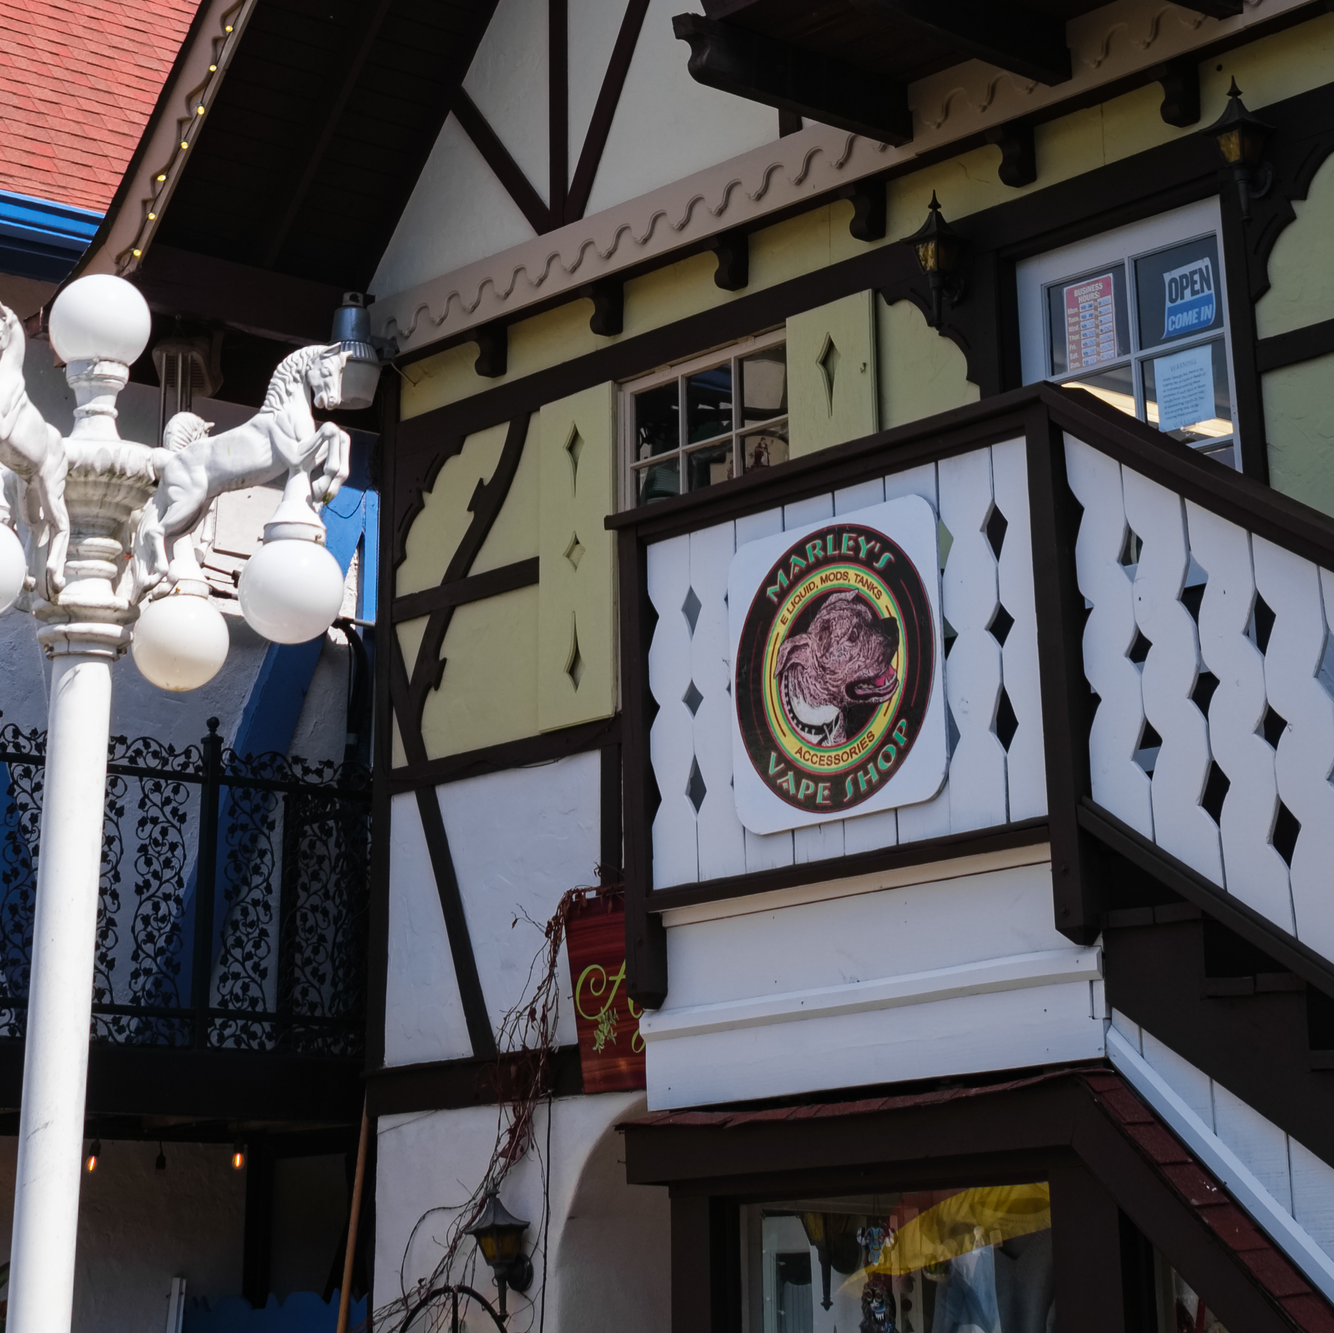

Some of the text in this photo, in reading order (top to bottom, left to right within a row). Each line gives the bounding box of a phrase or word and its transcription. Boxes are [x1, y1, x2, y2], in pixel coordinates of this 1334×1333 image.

[1074, 282, 1103, 297] BUSINESS
[1168, 264, 1212, 305] OPEN
[1168, 304, 1213, 331] COME IN
[766, 532, 896, 605] MARLEY'S
[779, 570, 884, 627] E LIQUID, MODS, TANKS
[768, 718, 909, 806] VAPE SHOP
[794, 729, 876, 767] ACCESSORIES
